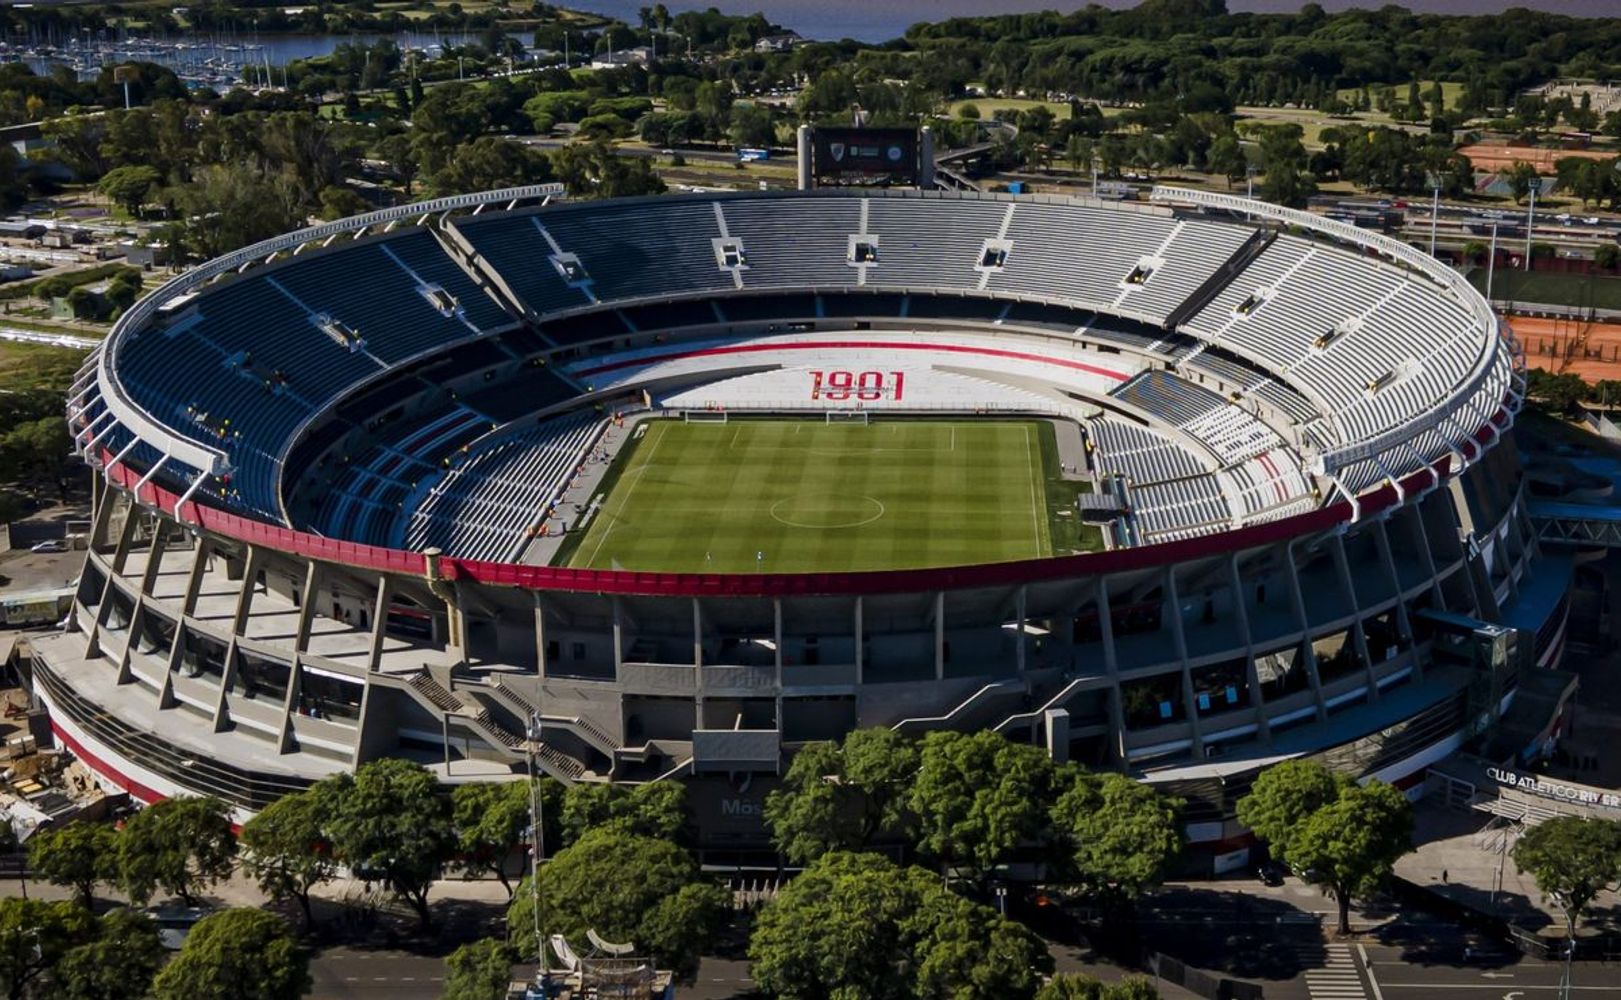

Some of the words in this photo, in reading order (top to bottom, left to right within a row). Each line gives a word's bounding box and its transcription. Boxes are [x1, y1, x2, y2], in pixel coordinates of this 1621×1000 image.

[809, 371, 904, 401] 1901
[1486, 767, 1517, 786] CLUB
[1579, 791, 1620, 807] RIVER
